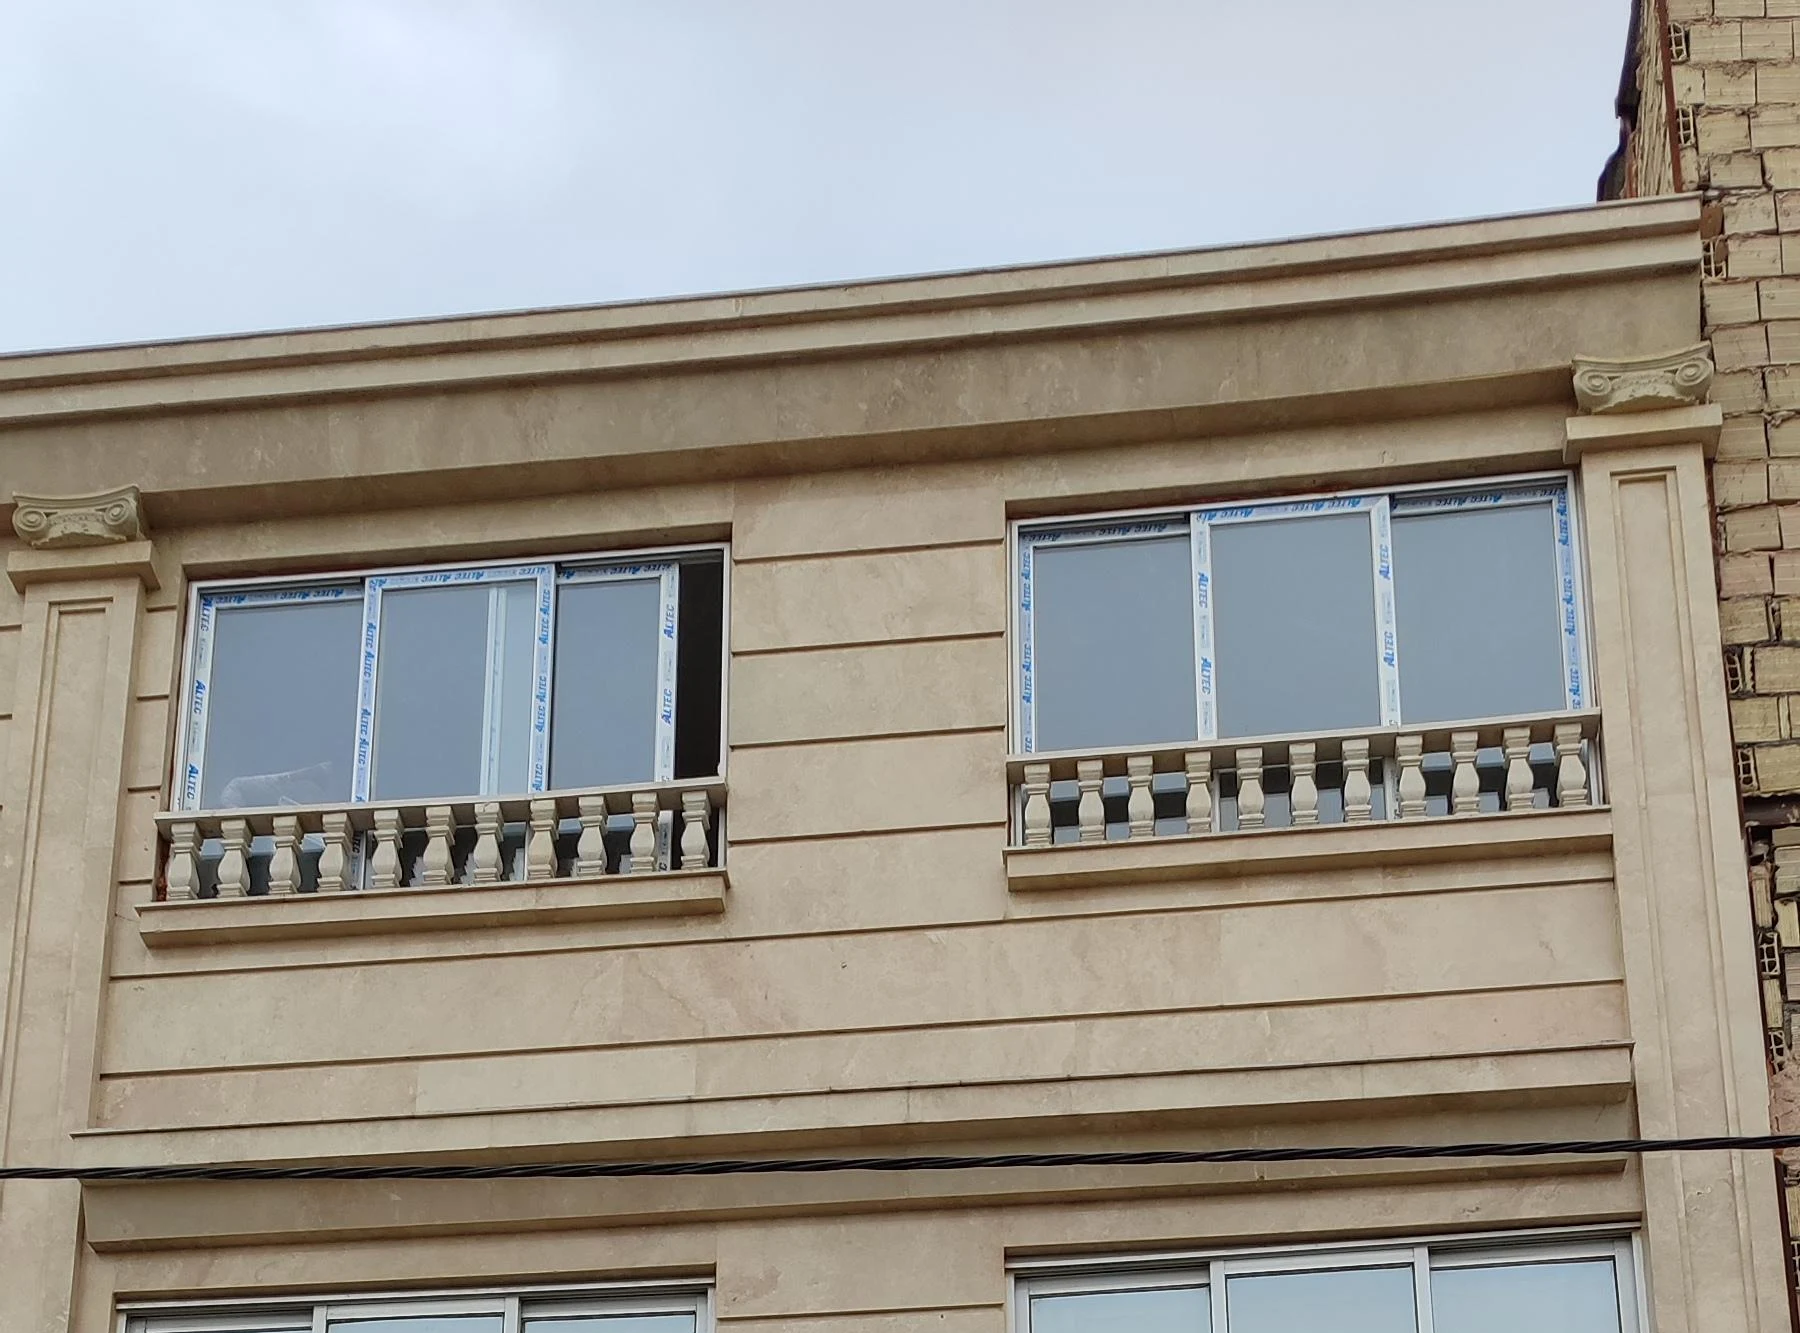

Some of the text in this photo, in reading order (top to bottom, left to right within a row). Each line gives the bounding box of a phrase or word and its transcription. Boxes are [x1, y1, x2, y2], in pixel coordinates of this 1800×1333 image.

[662, 604, 676, 726] ALTEC ALTEC
[1198, 571, 1212, 695] ALTEC ALTEC
[1379, 544, 1395, 668] ALTEC ALTEC
[186, 597, 213, 800] ALTEC ALTEC ALTEC
